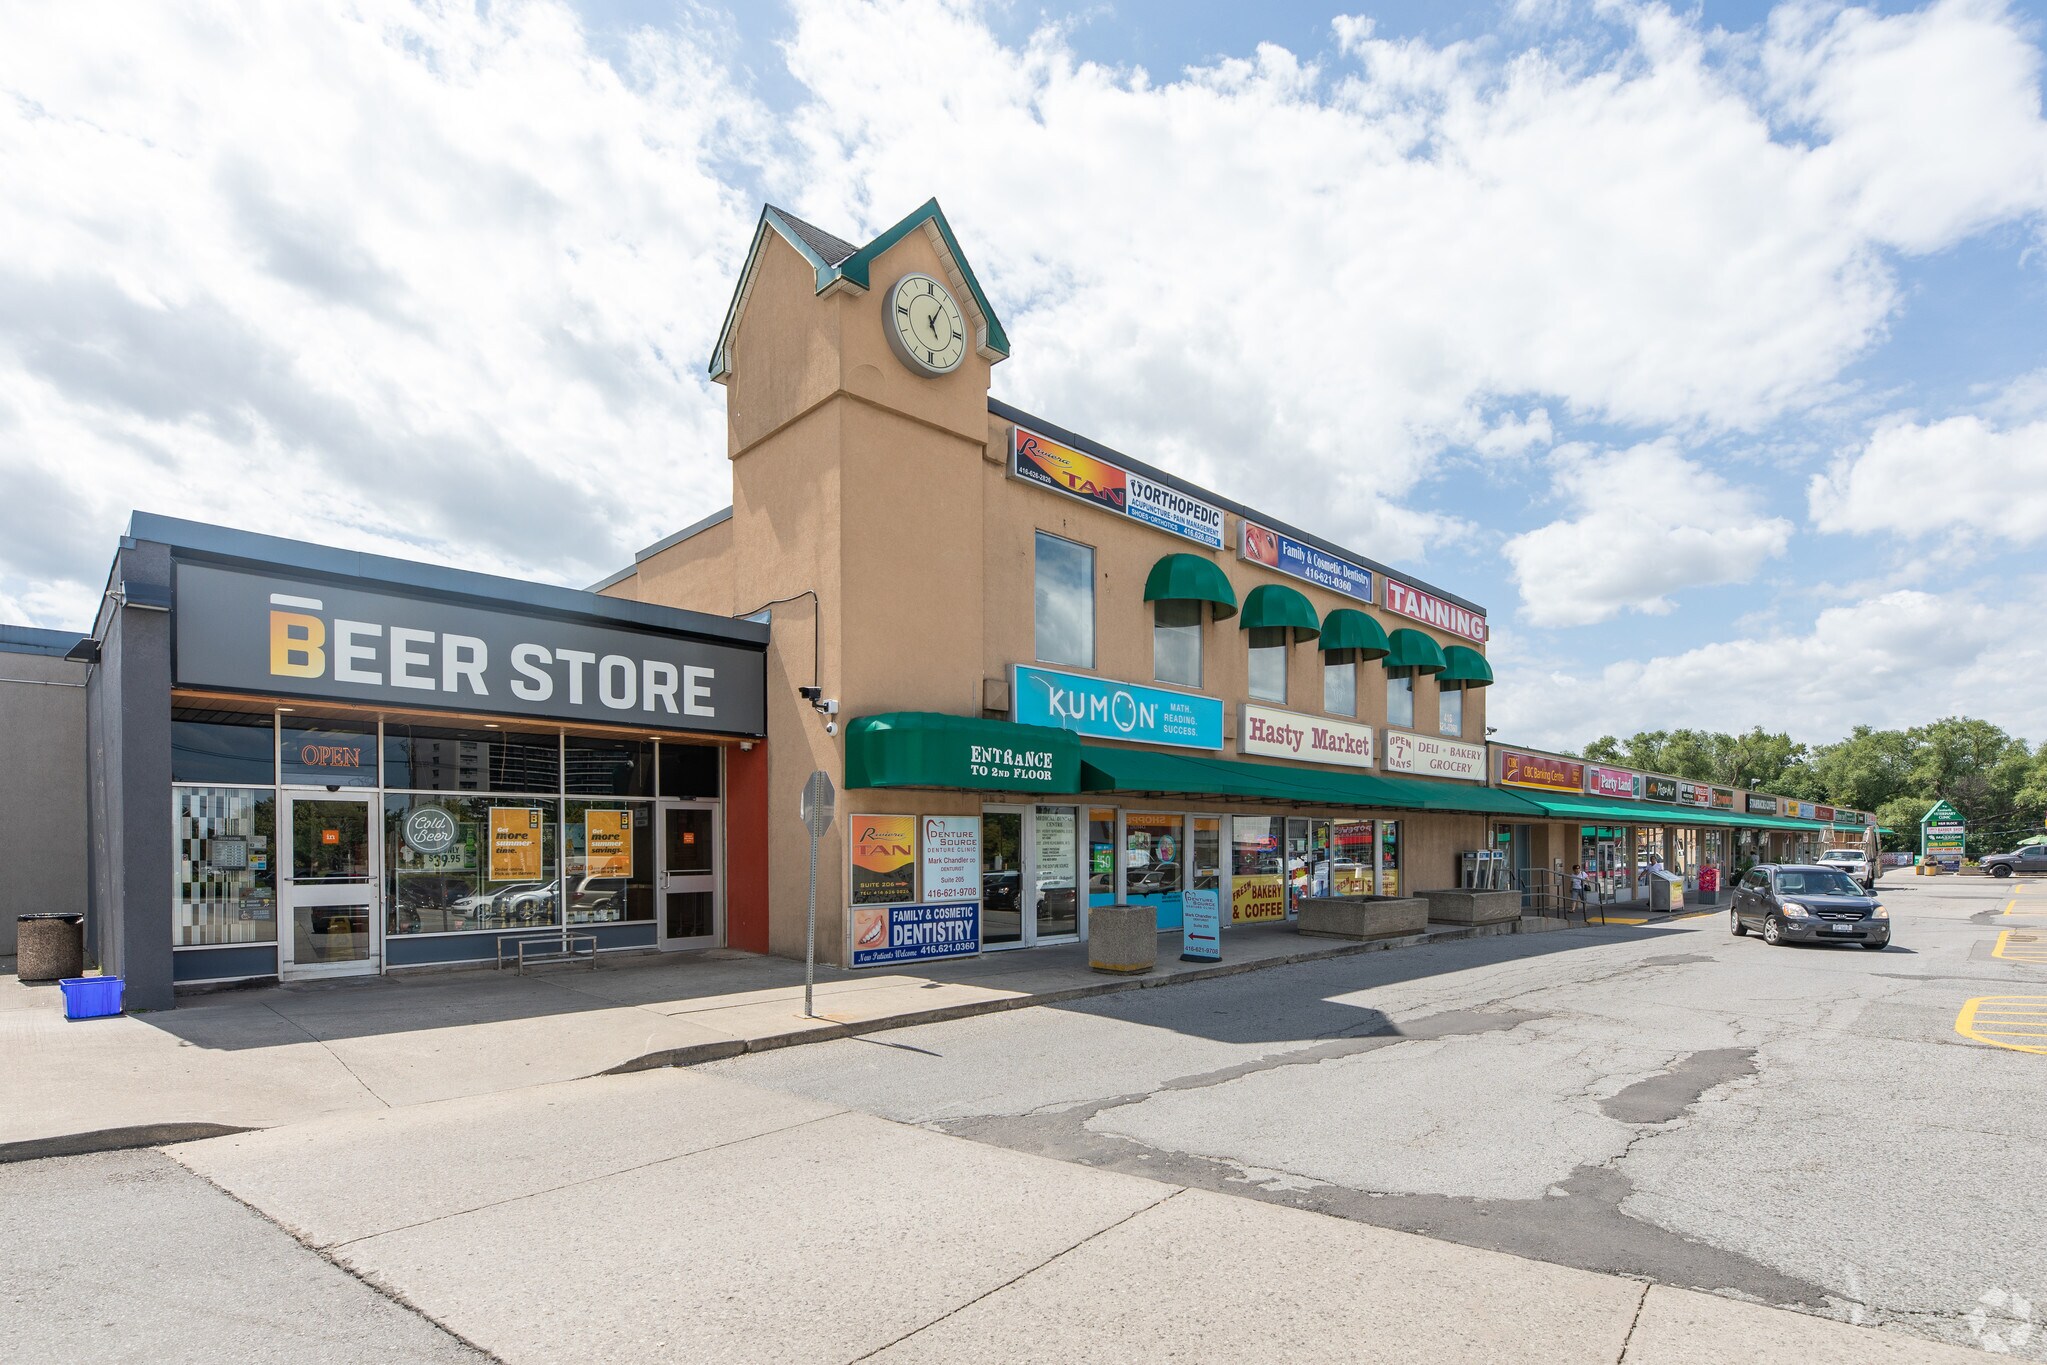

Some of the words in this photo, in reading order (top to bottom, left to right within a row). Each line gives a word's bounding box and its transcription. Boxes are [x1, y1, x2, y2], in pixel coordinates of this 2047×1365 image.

[1018, 438, 1071, 466] Riviera
[1062, 470, 1124, 506] TAN
[1144, 484, 1220, 527] ORTHOPEDIC
[1131, 498, 1170, 520] ACUPUNCTURE
[1173, 514, 1186, 524] PAIN
[1186, 519, 1219, 536] MANAGEMENT
[1150, 517, 1178, 531] ORTHOTICS
[1282, 540, 1306, 564] Family
[1307, 552, 1312, 564] &
[1314, 554, 1342, 576] Cosmetic
[1343, 564, 1370, 589] Dentistry
[1305, 568, 1352, 592] 416-621-0360
[1390, 582, 1484, 640] TANNING
[270, 593, 489, 696] BEER
[510, 643, 715, 718] STORE
[1170, 703, 1192, 714] MATH.
[1164, 713, 1198, 725] READING.
[1163, 724, 1198, 737] SUCCESS.
[1249, 716, 1304, 752] Hasty
[1312, 726, 1369, 756] Market
[1390, 736, 1412, 750] OPEN
[1418, 742, 1439, 754] DELI
[1450, 746, 1482, 760] BAKERY
[301, 744, 360, 768] OPEN
[970, 746, 1052, 768] ENTRANCE
[1396, 746, 1404, 759] 7
[1390, 758, 1412, 769] DAYS
[1429, 758, 1472, 773] GROCERY
[1508, 757, 1518, 768] CIBC
[971, 764, 988, 776] TO
[992, 768, 1010, 778] 2ND
[1014, 768, 1052, 781] FLOOR
[1524, 766, 1534, 778] CIBC
[1534, 767, 1550, 783] Banking
[1552, 770, 1564, 782] Centre
[1601, 774, 1616, 792] Party
[1618, 777, 1631, 792] Land
[414, 816, 446, 829] Cold
[414, 829, 449, 843] Beer
[855, 844, 911, 856] TAN
[928, 888, 976, 898] 416-621-9708
[1232, 880, 1252, 901] FRESH
[1252, 884, 1282, 899] BAKERY
[893, 910, 923, 922] FAMILY
[926, 911, 932, 920] &
[934, 907, 973, 919] COSMETIC
[1232, 905, 1240, 919] &
[1245, 902, 1282, 918] COFFEE
[894, 920, 974, 946] DENTISTRY
[872, 950, 894, 960] Patients
[895, 950, 917, 958] Welcome
[921, 942, 975, 954] 416.621.0360
